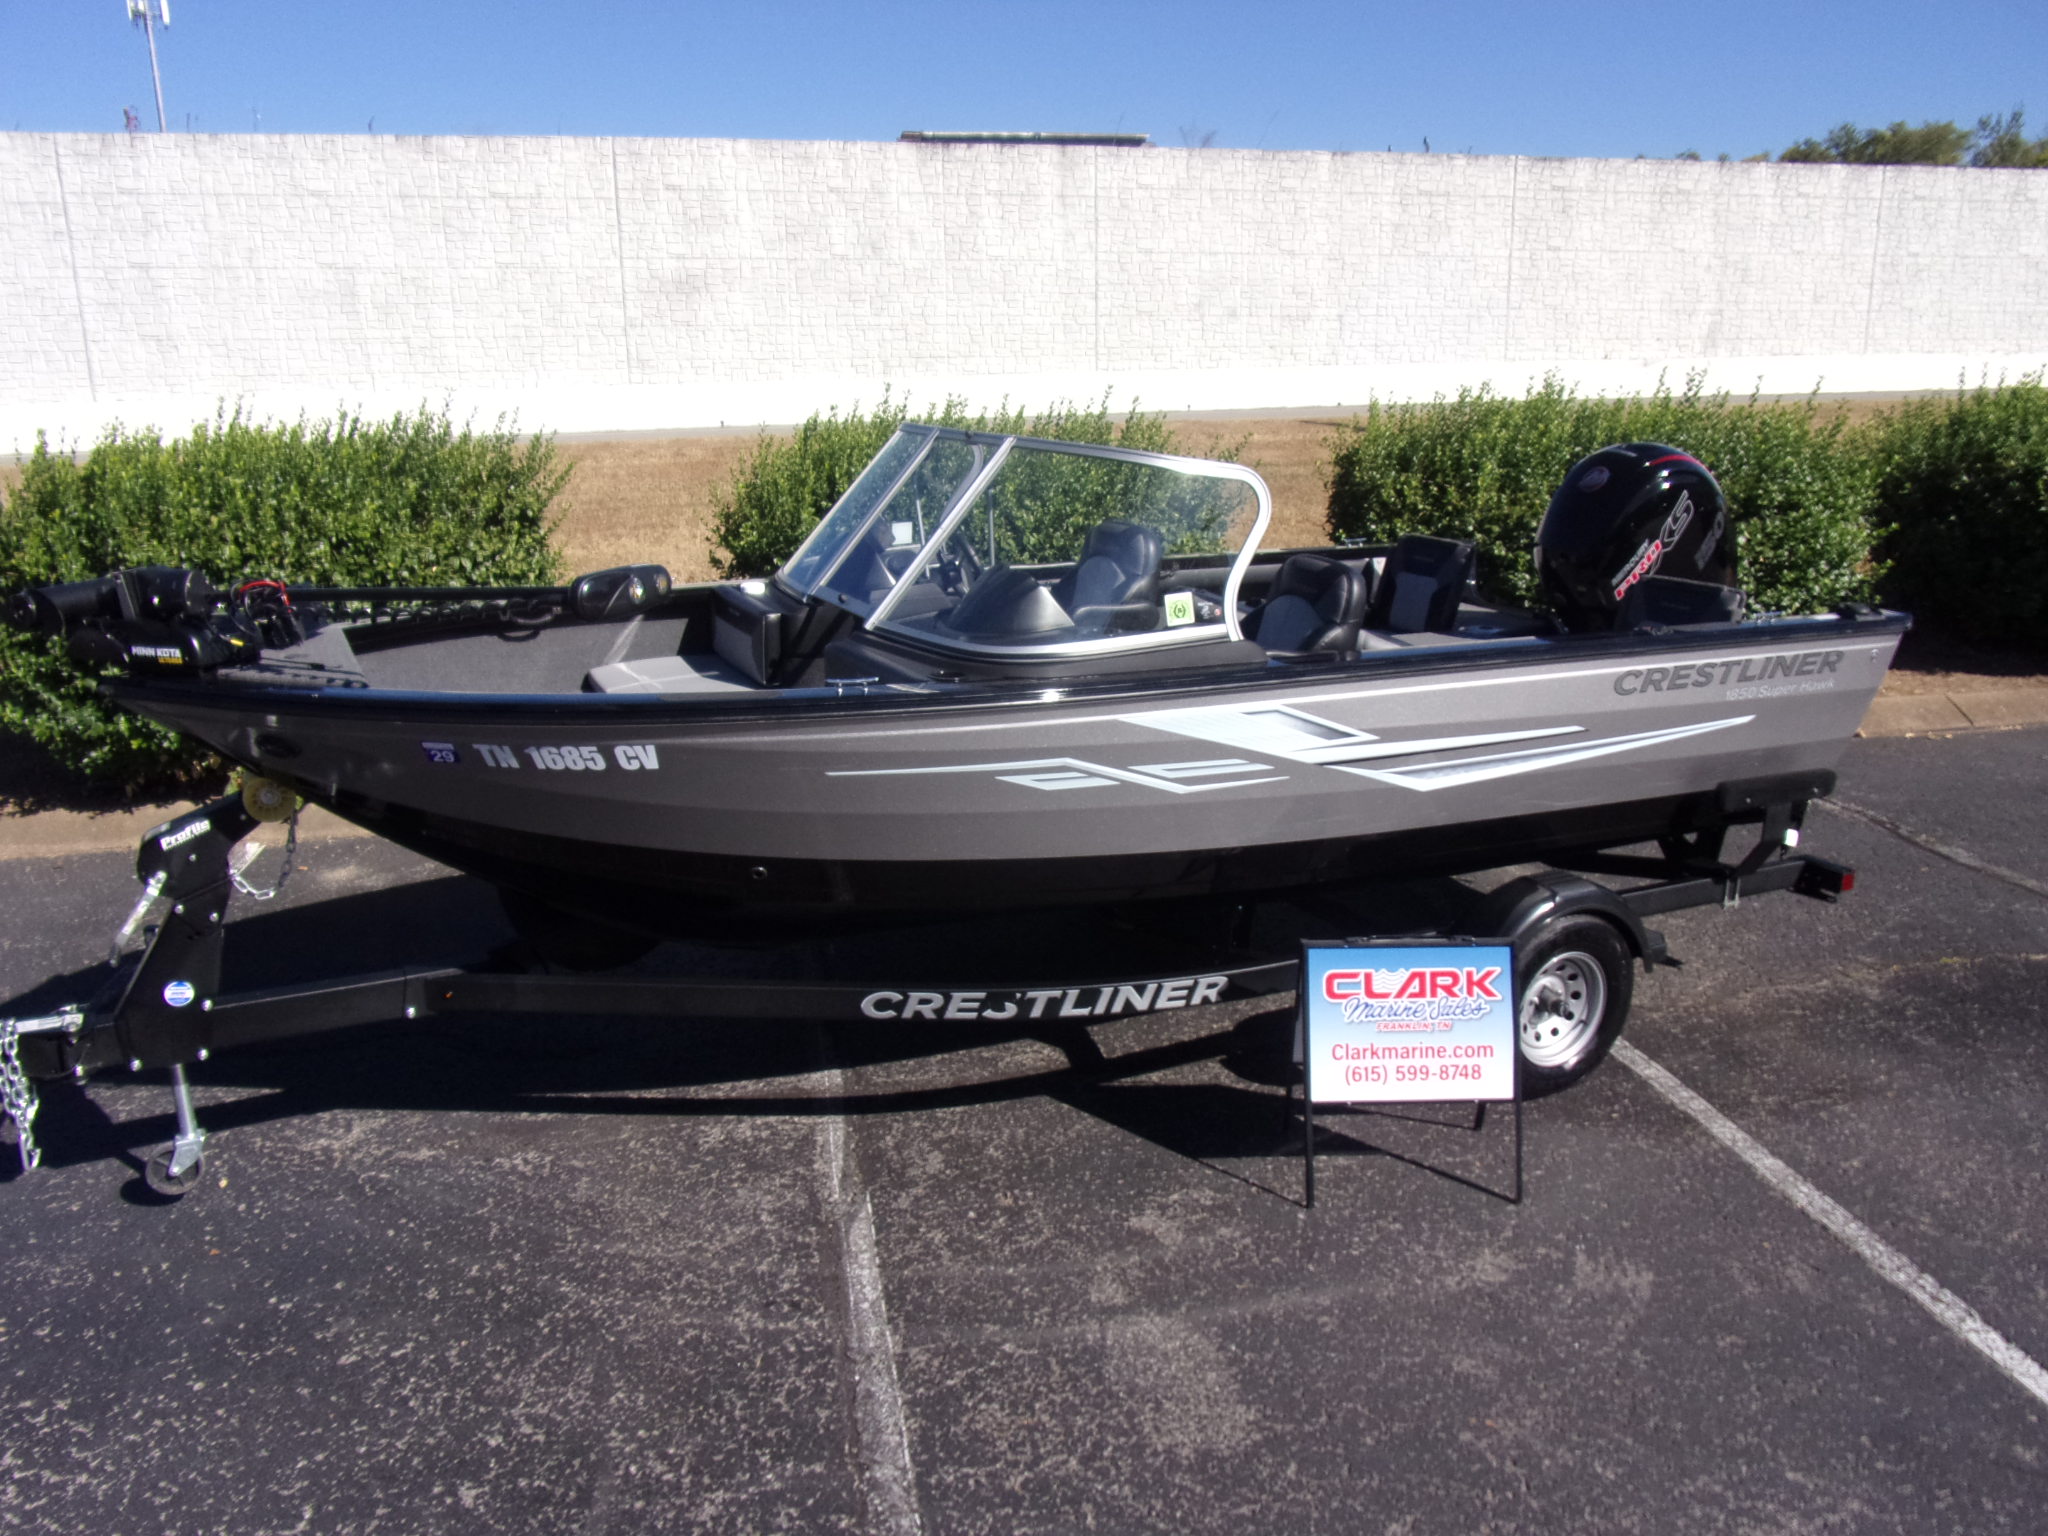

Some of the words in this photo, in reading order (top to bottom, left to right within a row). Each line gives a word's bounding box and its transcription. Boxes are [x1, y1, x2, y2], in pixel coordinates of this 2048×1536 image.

[156, 648, 181, 658] KOTA
[1614, 650, 1846, 696] CRESTLINER
[1758, 683, 1797, 699] Super
[1800, 678, 1835, 693] Hawk
[430, 750, 455, 763] 29
[472, 743, 520, 769] TN
[524, 745, 607, 771] 1685
[614, 744, 660, 770] CV
[160, 819, 212, 852] Profile
[1324, 968, 1500, 1000] CLARK
[1344, 997, 1426, 1020] Marine
[1431, 996, 1489, 1019] Sales
[1437, 1021, 1452, 1031] TN
[1331, 1042, 1494, 1061] Clarkmarine.com
[1345, 1065, 1388, 1086] (615)
[1395, 1064, 1482, 1082] 599-8748
